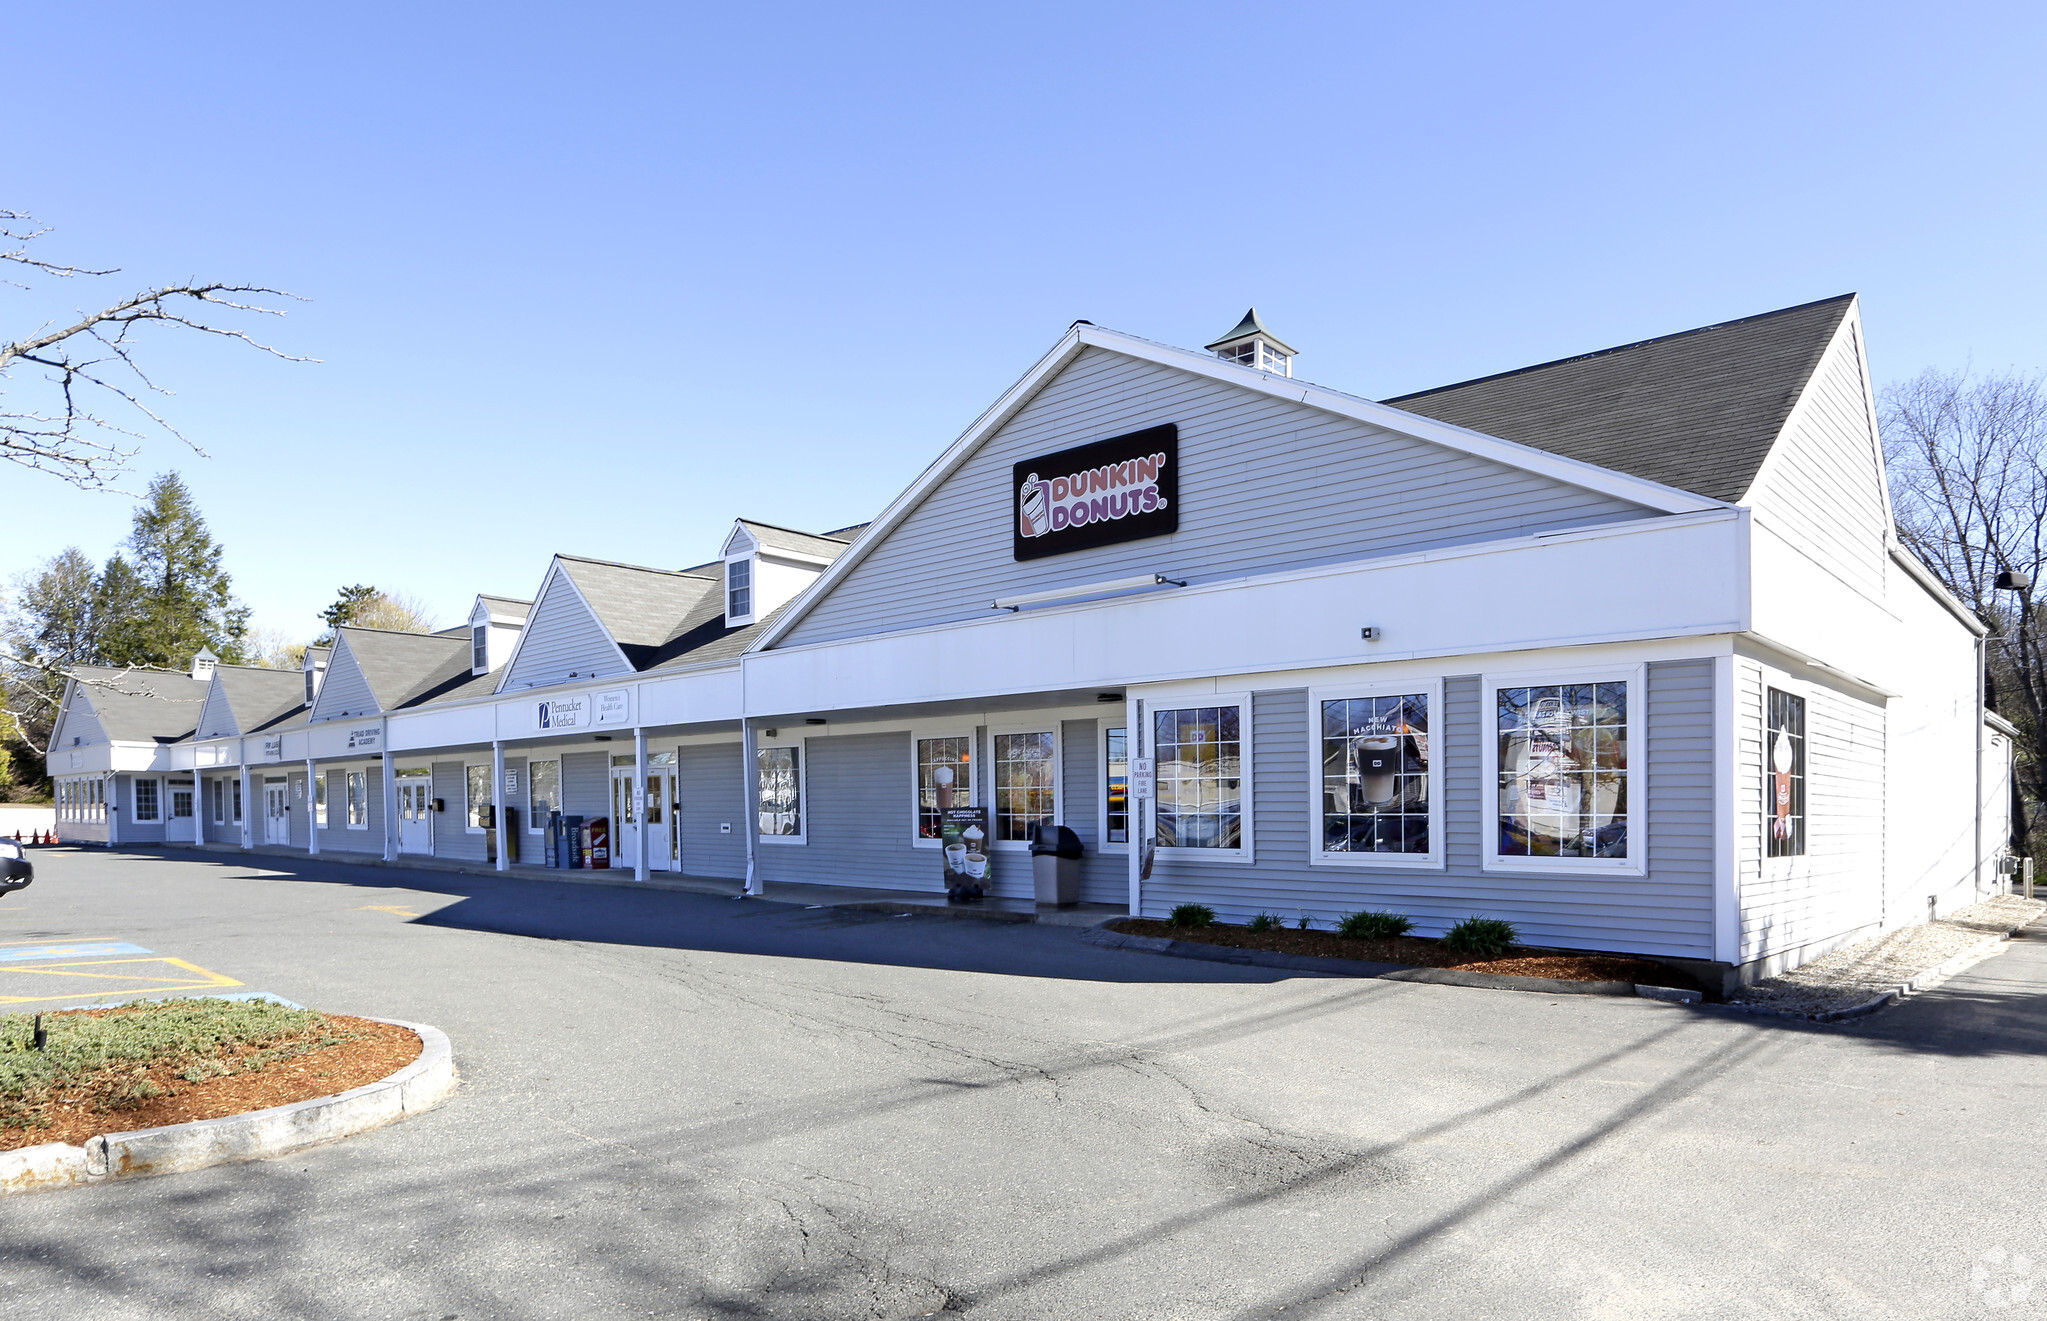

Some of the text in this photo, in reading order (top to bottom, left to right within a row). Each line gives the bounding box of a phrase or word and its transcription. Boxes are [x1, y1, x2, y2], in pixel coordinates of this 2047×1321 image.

[1052, 454, 1165, 502] DUNKIN'
[1052, 485, 1158, 530] DONUTS
[551, 698, 582, 714] Pentucket
[551, 713, 576, 727] Medical
[1353, 723, 1403, 735] MACCHIATO
[571, 827, 580, 863] Broadside
